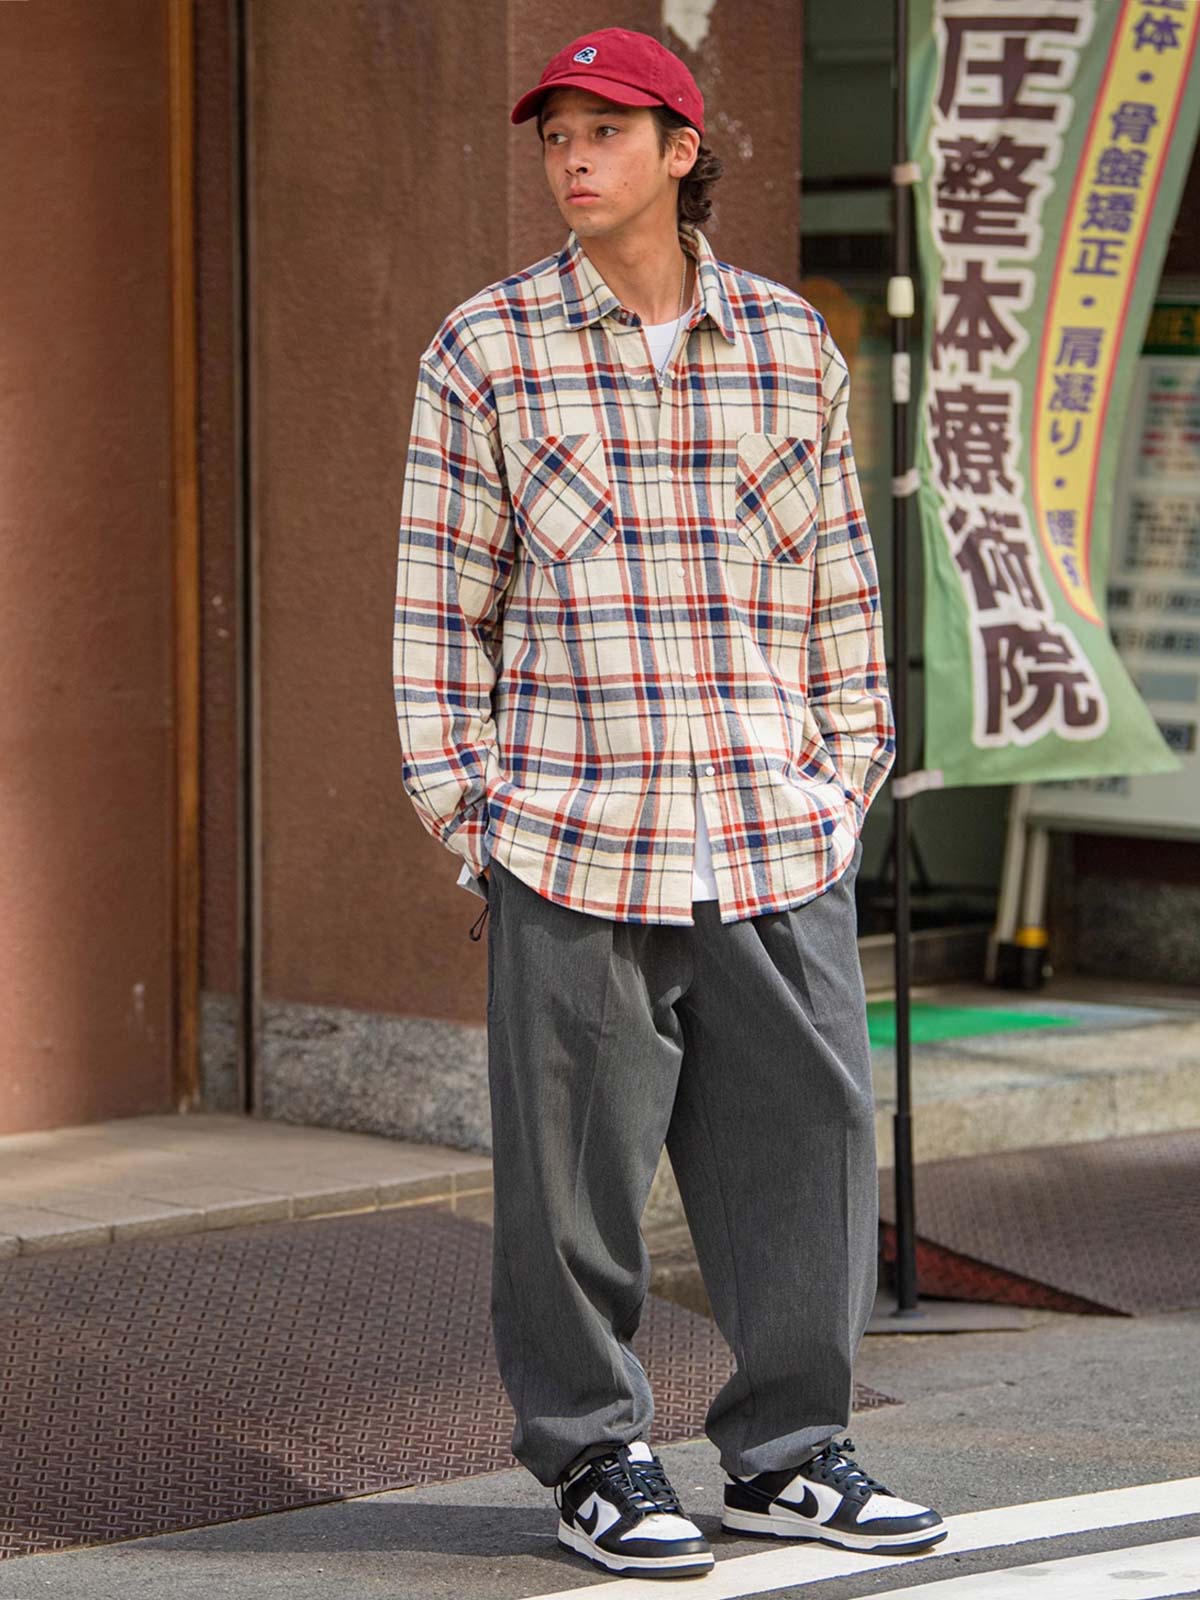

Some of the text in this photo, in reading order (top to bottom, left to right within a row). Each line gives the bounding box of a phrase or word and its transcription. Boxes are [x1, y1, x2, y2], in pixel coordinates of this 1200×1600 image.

[930, 0, 1099, 736] 圧整体療術院
